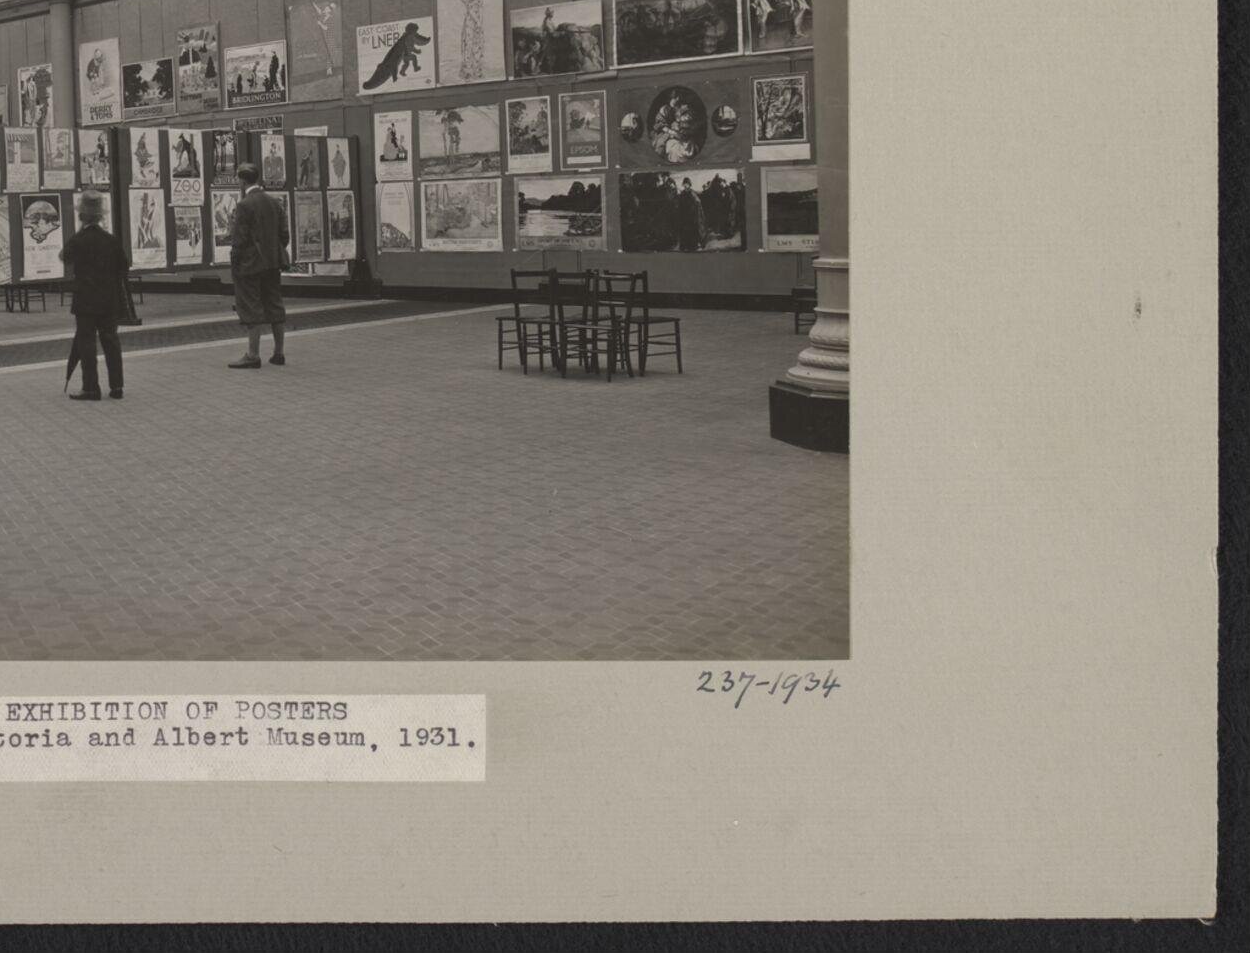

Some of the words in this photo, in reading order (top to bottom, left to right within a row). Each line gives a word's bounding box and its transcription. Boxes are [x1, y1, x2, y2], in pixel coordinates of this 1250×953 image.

[697, 670, 841, 709] 237-1934
[6, 701, 168, 722] EXHIBITION
[186, 701, 218, 720] OF
[235, 701, 348, 721] POSTERS
[88, 727, 136, 747] and
[153, 726, 249, 747] Albert
[267, 727, 378, 752] Museum,
[399, 726, 476, 748] 1931.
